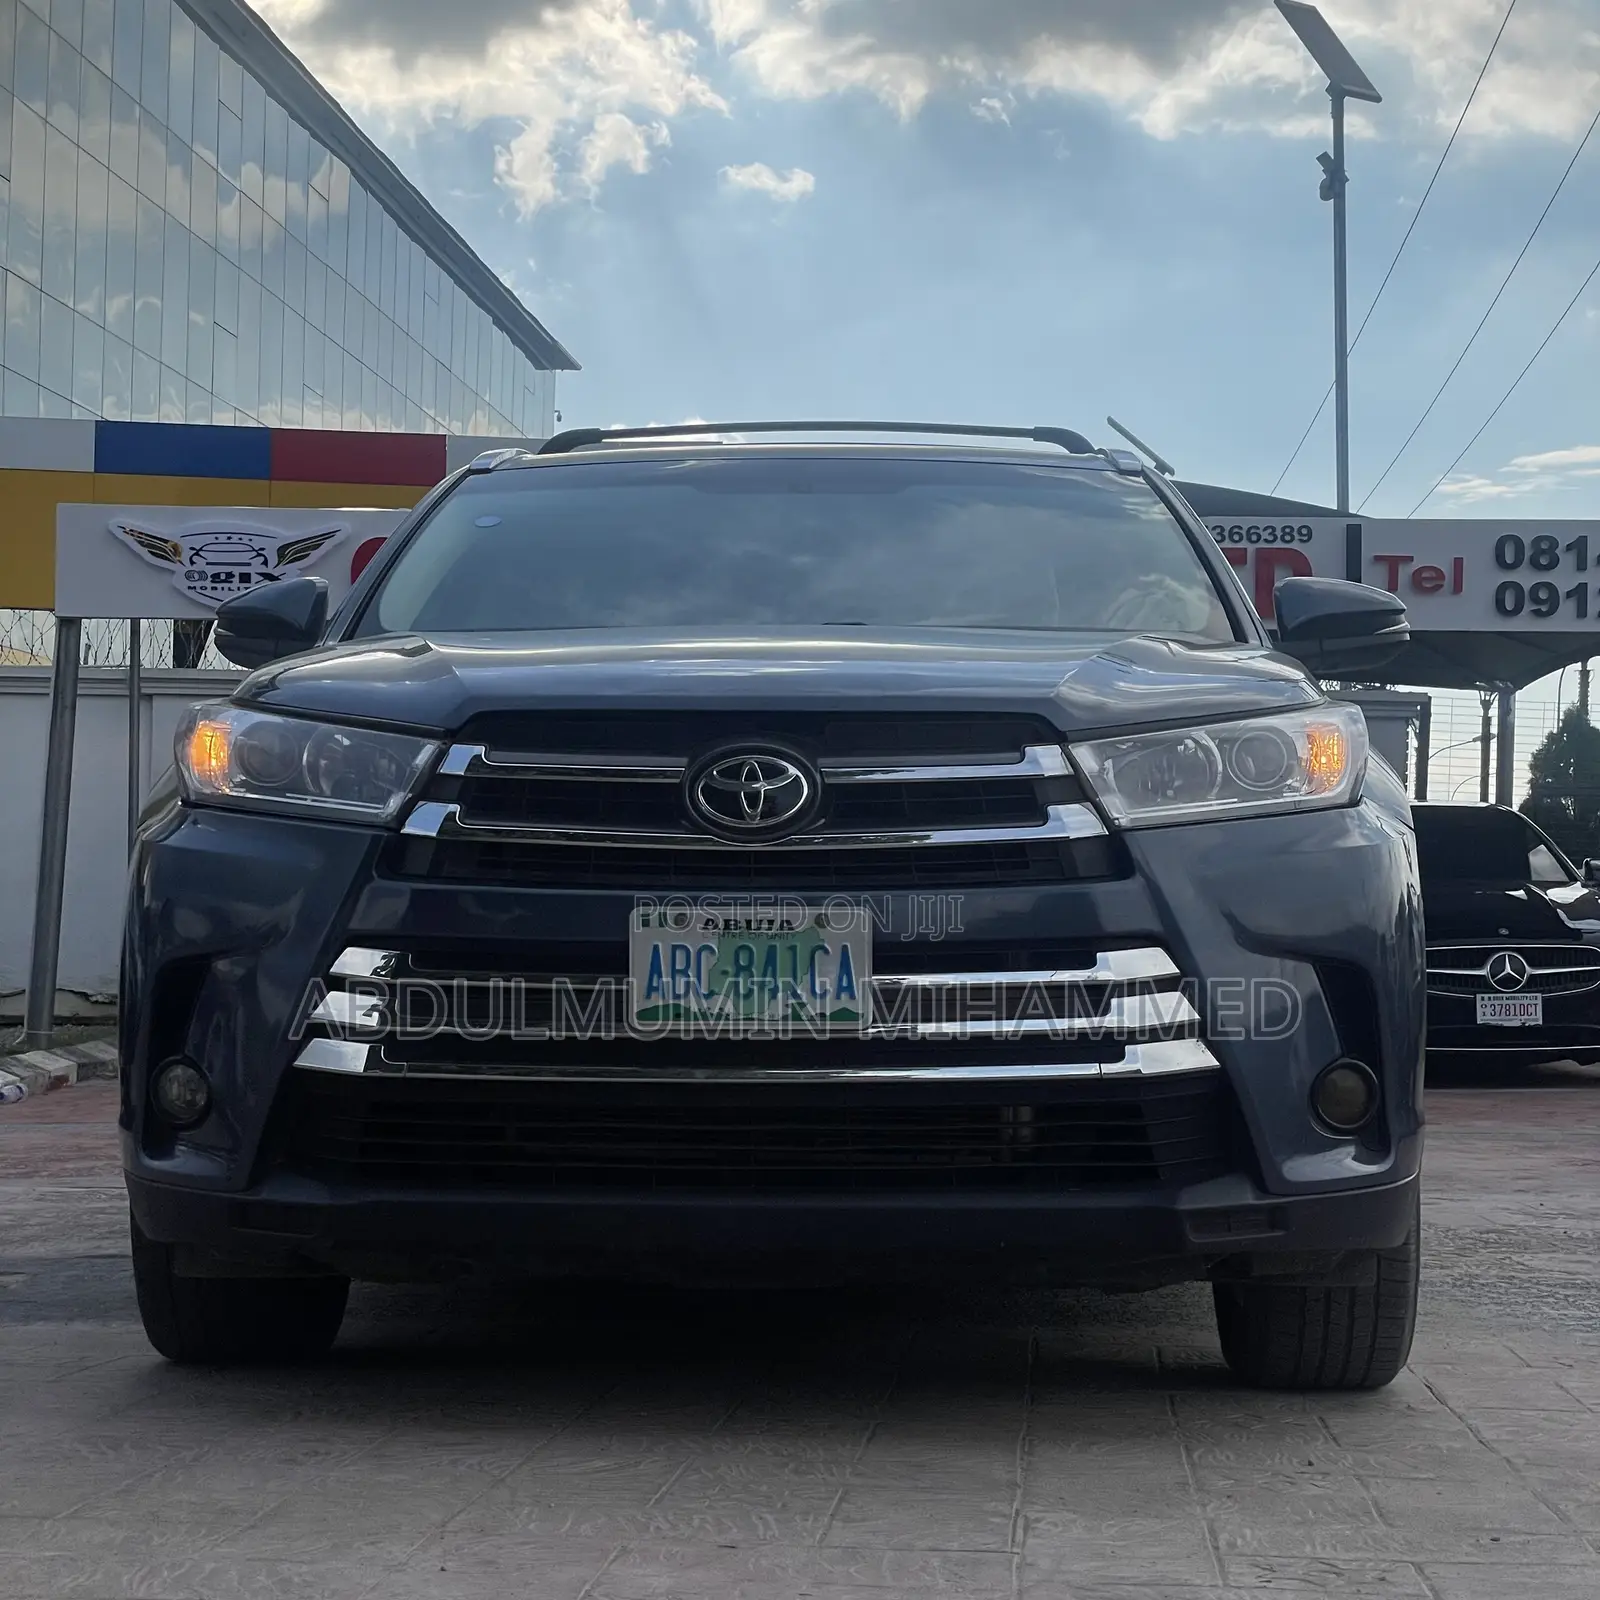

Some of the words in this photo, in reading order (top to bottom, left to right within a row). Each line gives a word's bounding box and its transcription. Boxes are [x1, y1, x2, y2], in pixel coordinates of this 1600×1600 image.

[1204, 524, 1313, 544] 366389
[1494, 533, 1600, 572] 081
[1373, 554, 1464, 595] Tel
[1494, 581, 1600, 618] 091
